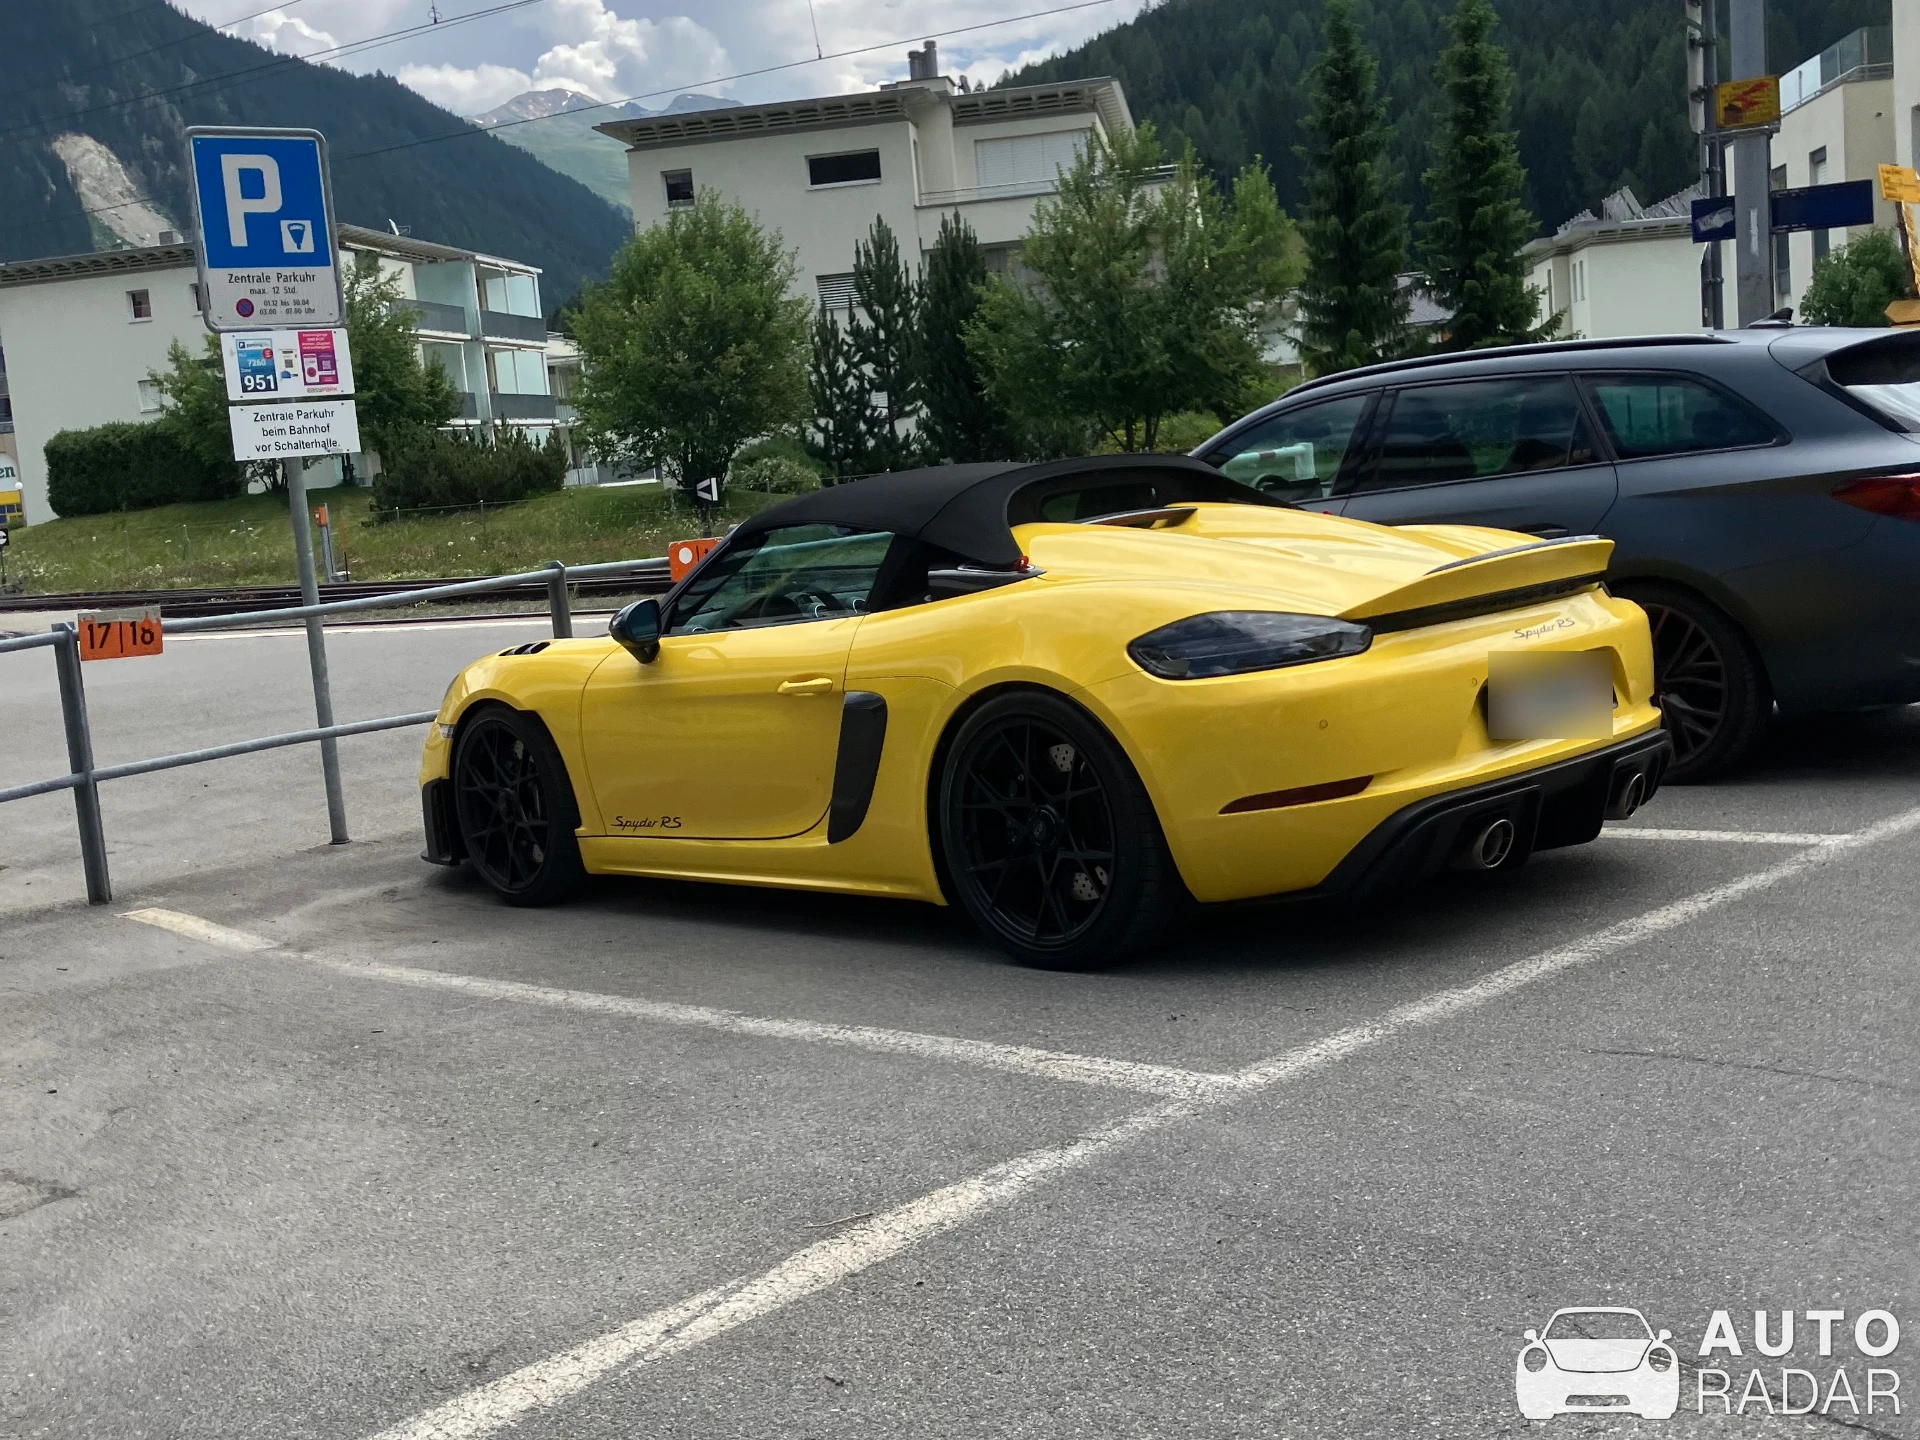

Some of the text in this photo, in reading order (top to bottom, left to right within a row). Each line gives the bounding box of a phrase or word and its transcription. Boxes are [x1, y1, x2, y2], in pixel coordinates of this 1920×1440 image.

[221, 154, 283, 247] P
[228, 271, 316, 284] Zentrale Parkuhr
[272, 286, 280, 294] 12
[305, 307, 316, 315] Uhr
[247, 358, 266, 367] 7260
[244, 374, 275, 391] 951
[253, 409, 335, 422] Zentrale Parkuhr
[262, 423, 330, 437] beim Bahnhof
[255, 443, 271, 452] vor
[1513, 617, 1575, 640] Spyder RS
[87, 622, 112, 649] 17
[610, 815, 682, 832] Spyder RS
